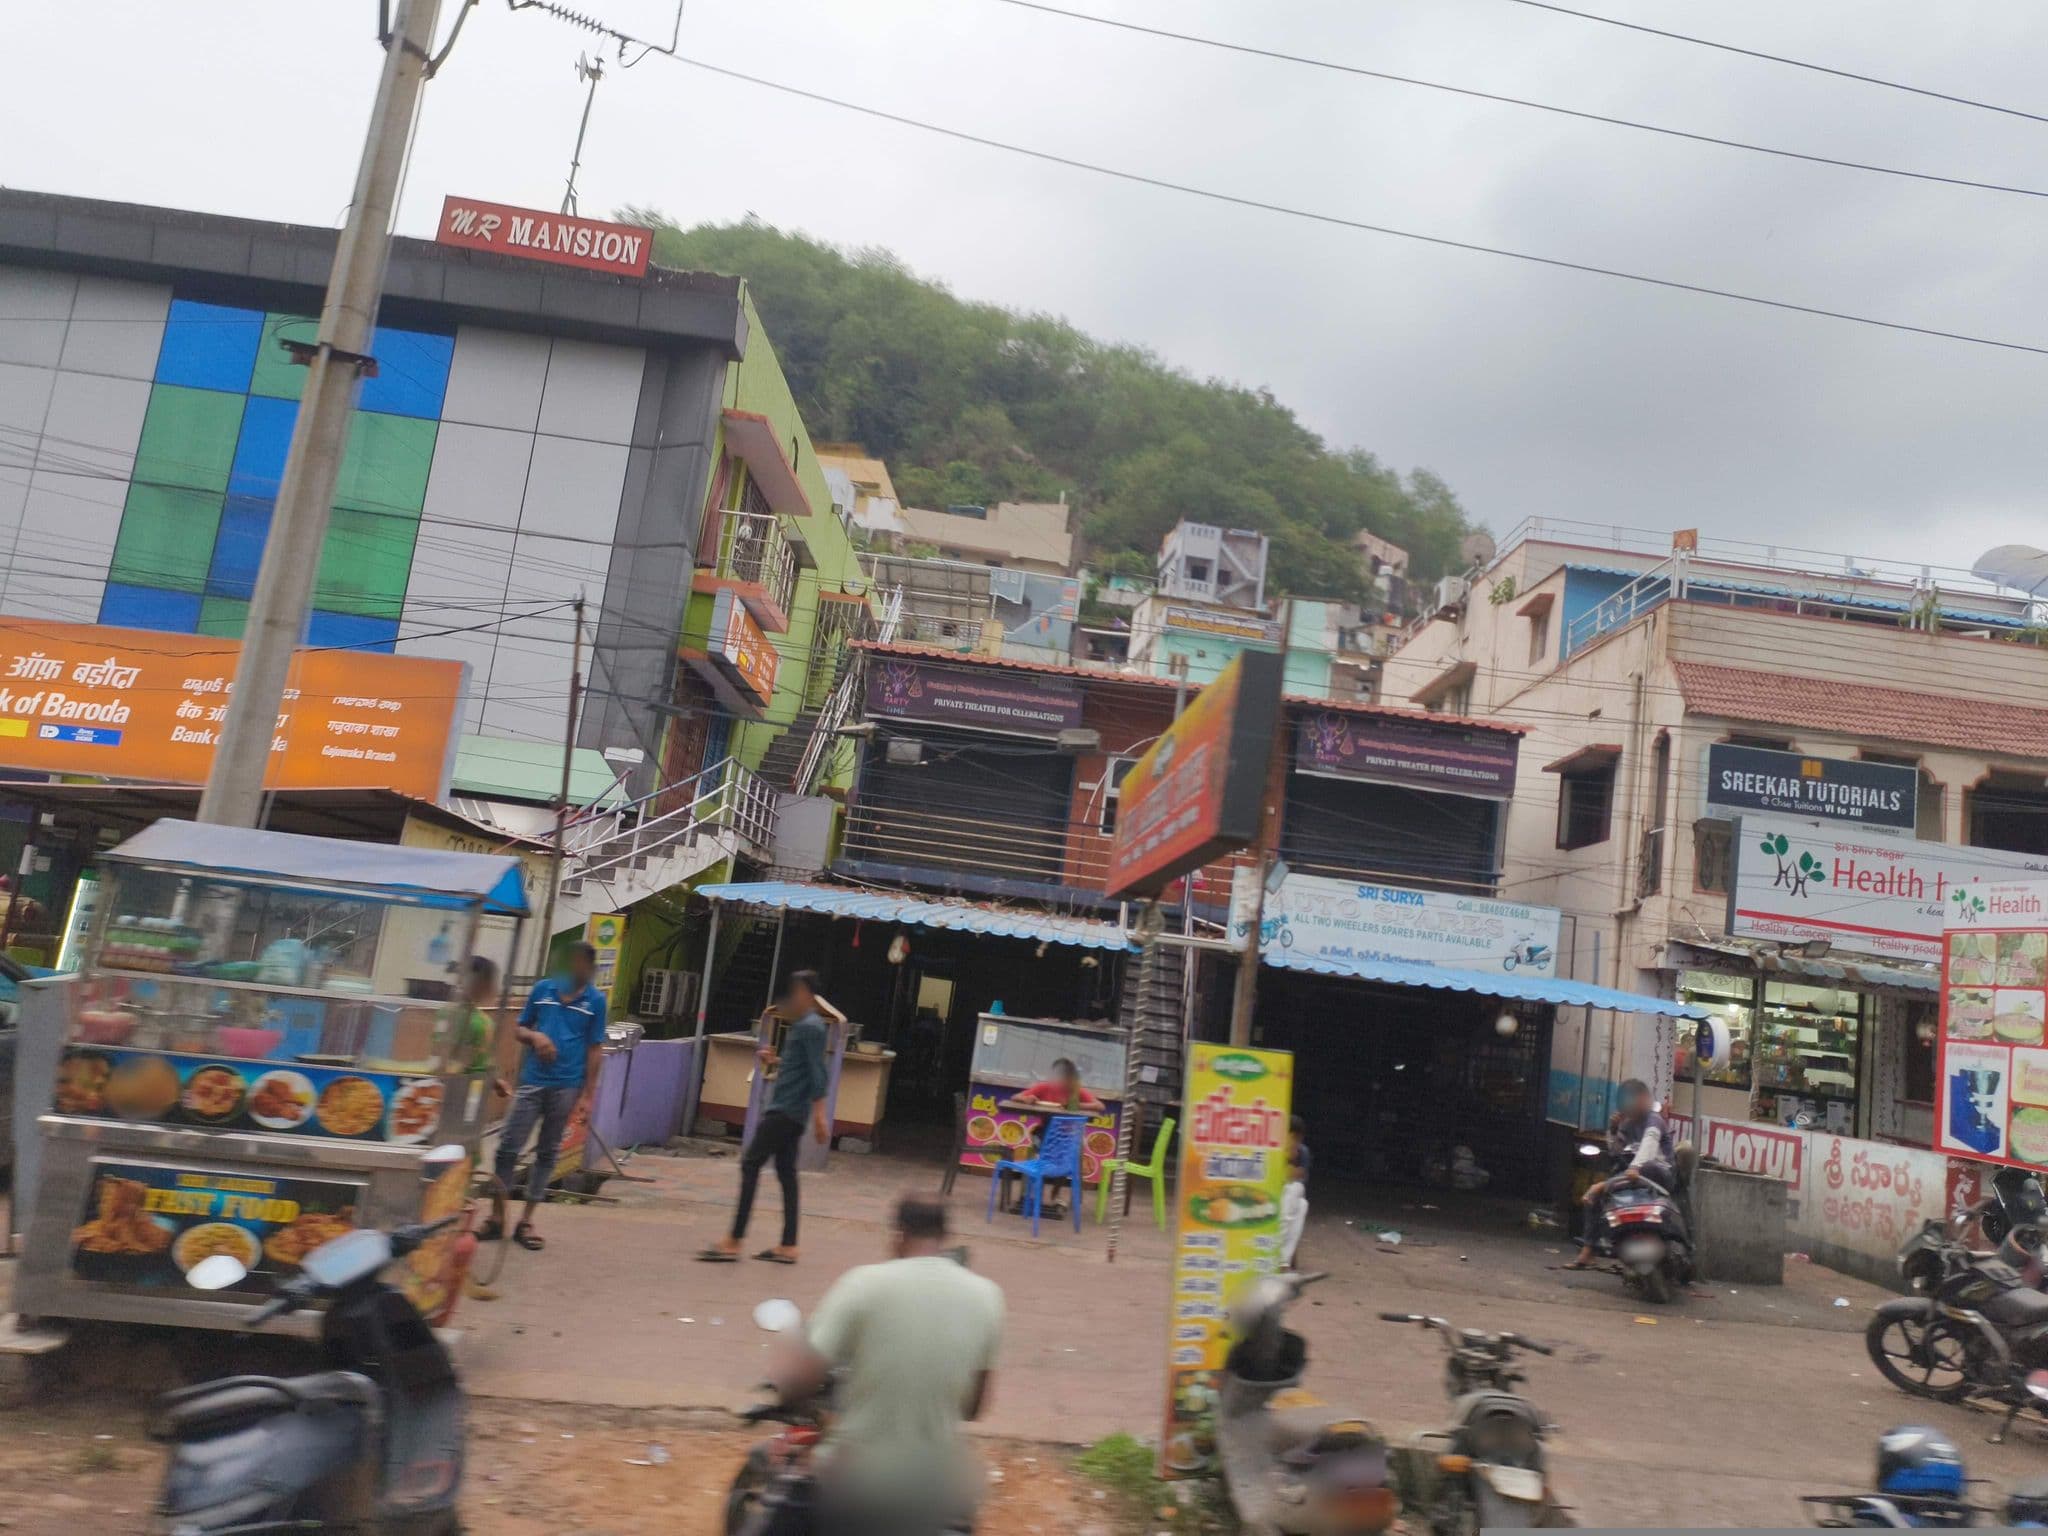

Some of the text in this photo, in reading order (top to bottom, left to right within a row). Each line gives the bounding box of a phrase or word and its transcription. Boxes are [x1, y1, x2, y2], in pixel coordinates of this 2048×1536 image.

[450, 207, 642, 265] MR MANSION
[72, 656, 143, 691] बड़ौदा
[14, 691, 44, 715] of
[41, 692, 131, 724] Baroda
[175, 698, 203, 719] बैंक
[934, 698, 1064, 722] PRIVATE THEATER FOR CELEBRATIONS
[170, 724, 212, 745] Bank
[364, 749, 397, 762] Branch
[1365, 755, 1499, 781] PRIVATE THEATER FOR CELEBRATIONS
[1721, 769, 1901, 811] SREEKAR TUTORIALS
[1793, 800, 1823, 812] Tuitions
[1825, 803, 1834, 814] VI
[1837, 806, 1846, 815] to
[1834, 842, 1849, 852] Sri
[1876, 847, 1905, 861] Sagar
[1833, 857, 1924, 899] Health
[1357, 885, 1425, 906] SRI SURYA
[1989, 894, 2041, 915] Health
[1294, 913, 1492, 949] ALL TWO WHEELERS SPARES PARTS AVAILABLE
[1373, 902, 1504, 939] SPARES
[1751, 919, 1788, 937] Healthy
[1872, 936, 1911, 953] Healthy
[1711, 1127, 1799, 1184] MOTUL
[1824, 1138, 1844, 1190] శ్రీ
